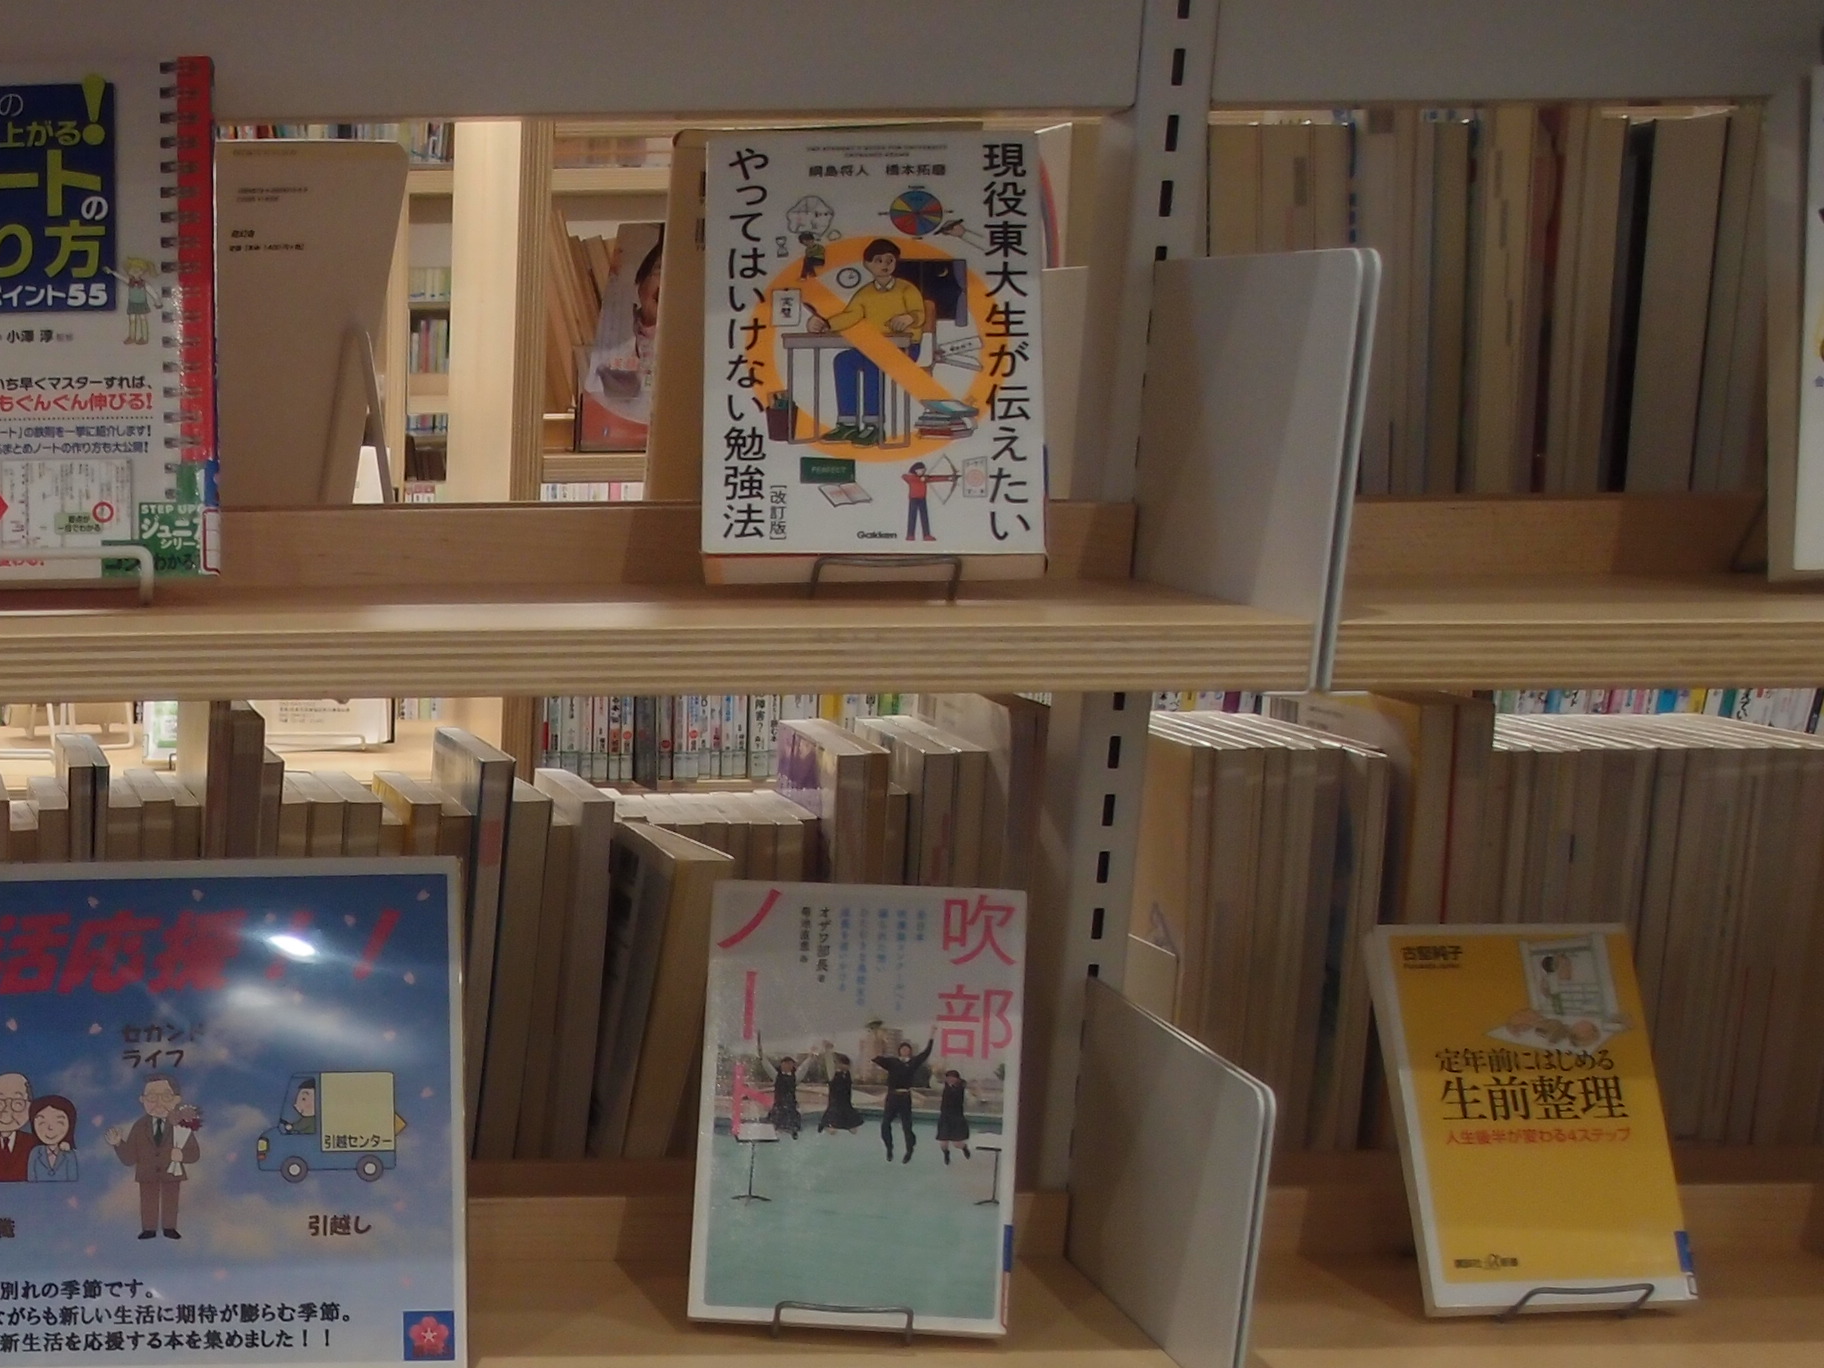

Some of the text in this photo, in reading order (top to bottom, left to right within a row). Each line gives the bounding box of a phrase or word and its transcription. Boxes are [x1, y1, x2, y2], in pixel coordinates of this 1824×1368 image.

[722, 146, 770, 541] やってはいけない勉強法
[982, 142, 1032, 542] 現役東大生が伝えたい
[140, 504, 174, 515] STEP
[935, 893, 1018, 1061] 吹部
[716, 888, 784, 1137] ノート
[121, 1047, 185, 1070] ライフ
[1434, 1047, 1615, 1074] 定年前にはじめる
[1441, 1074, 1630, 1122] 生前整理
[323, 1133, 394, 1151] 引越センター
[307, 1213, 373, 1237] 引越し
